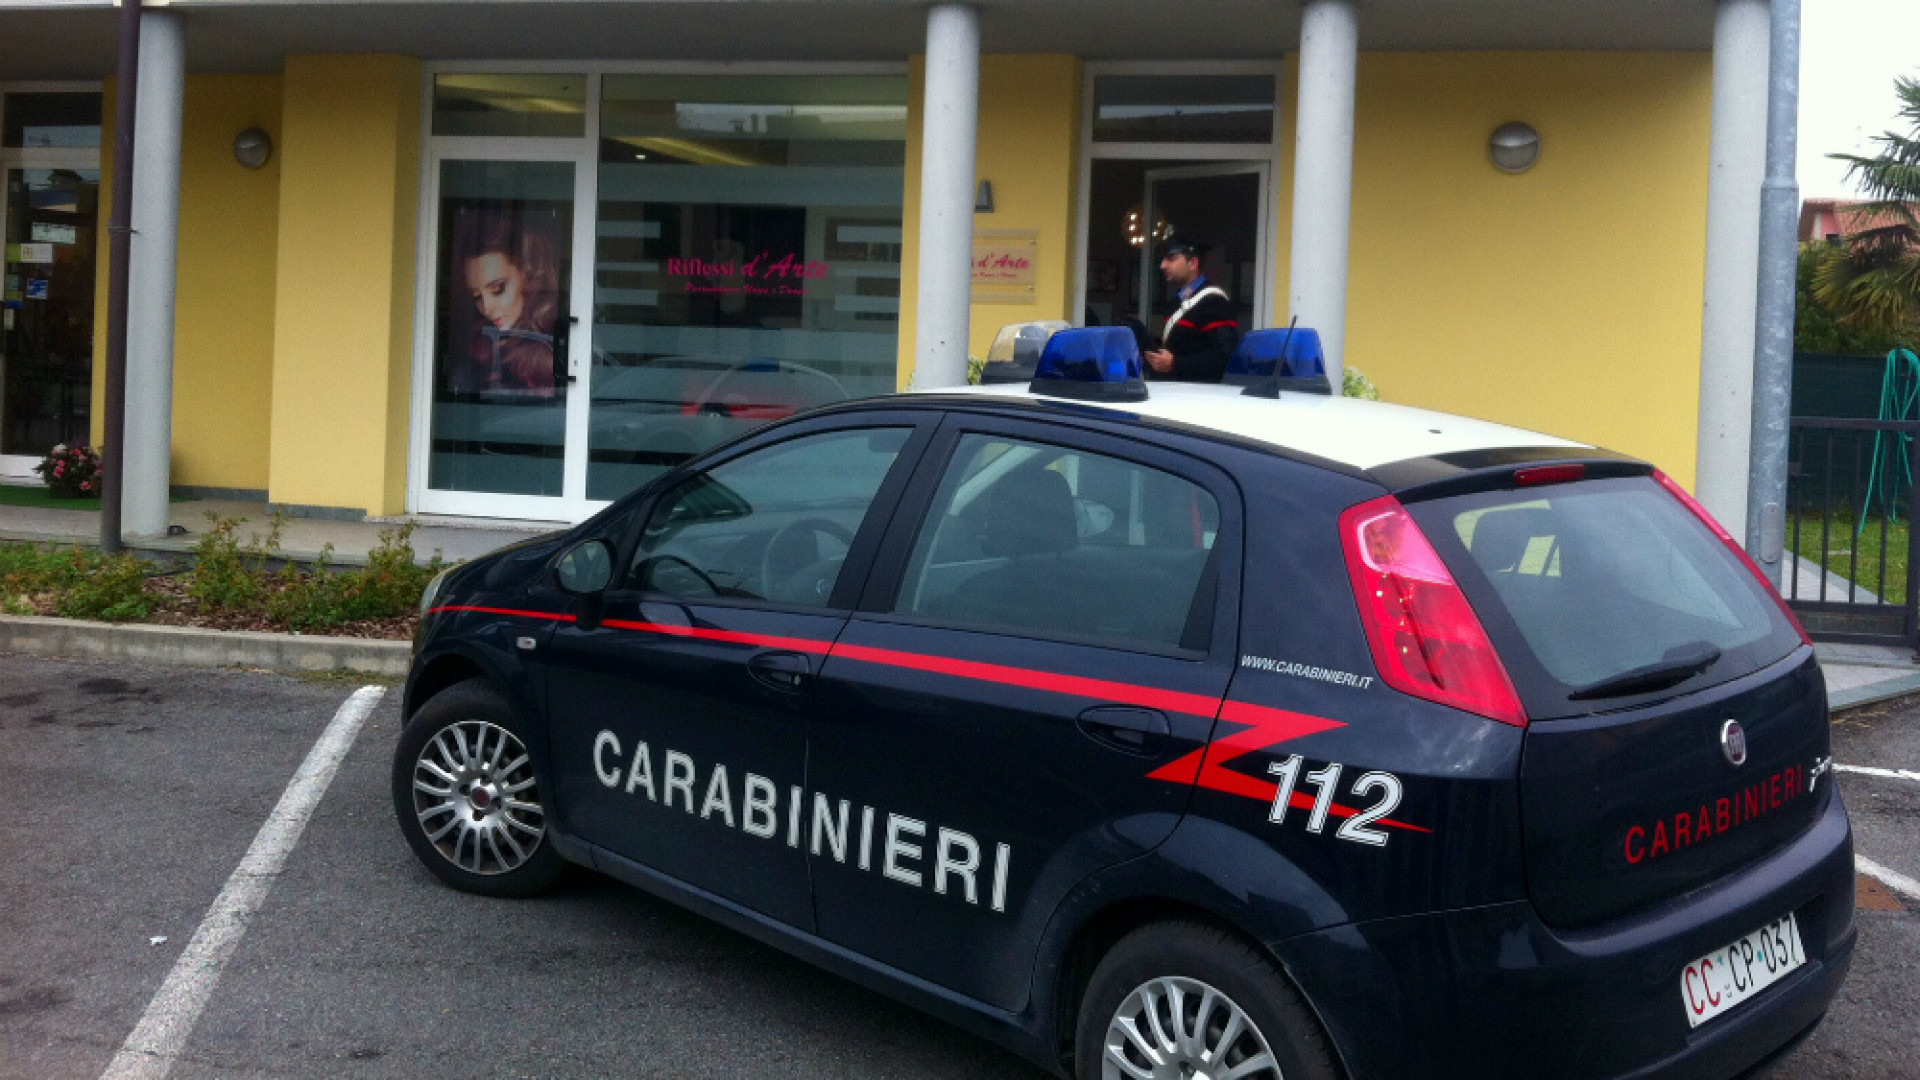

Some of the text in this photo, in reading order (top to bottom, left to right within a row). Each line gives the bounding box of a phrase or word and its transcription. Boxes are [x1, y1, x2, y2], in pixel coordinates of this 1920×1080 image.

[668, 257, 735, 276] Riflessi
[1241, 655, 1373, 689] WWW.CARABINIERI.IT
[593, 729, 1011, 913] CARABINIERI
[1267, 753, 1402, 847] 112
[1625, 763, 1803, 863] CARABINIERI
